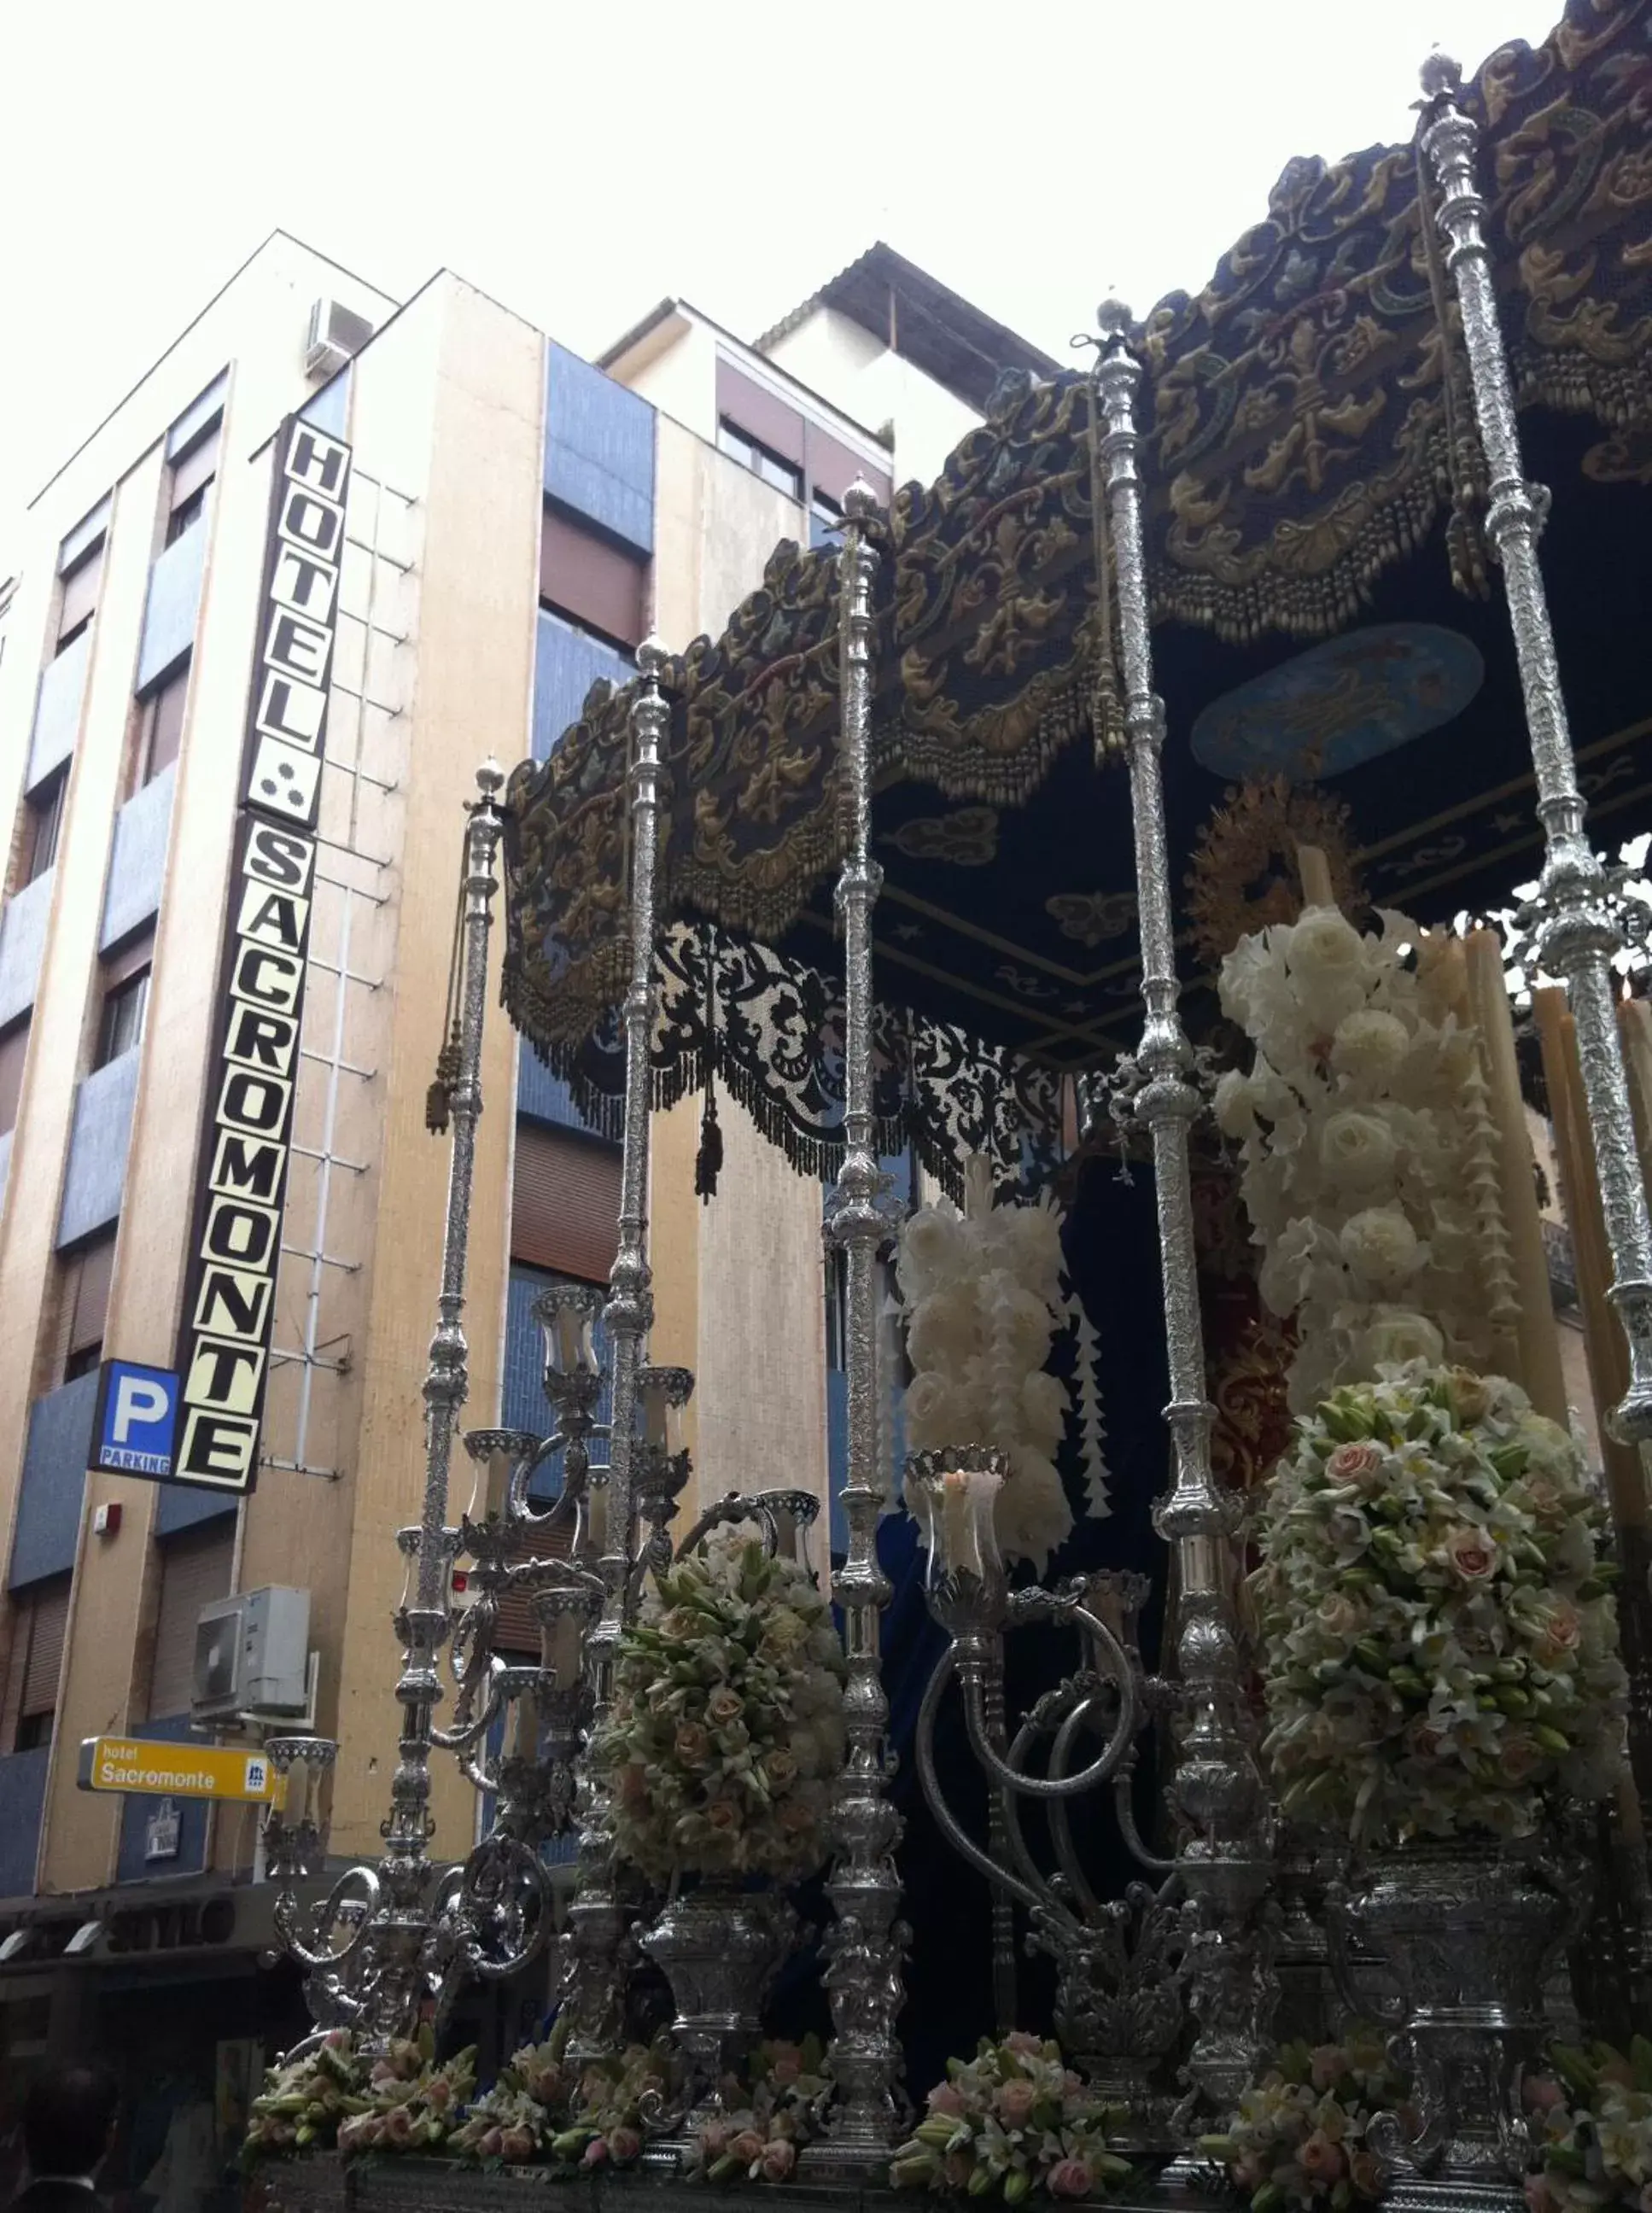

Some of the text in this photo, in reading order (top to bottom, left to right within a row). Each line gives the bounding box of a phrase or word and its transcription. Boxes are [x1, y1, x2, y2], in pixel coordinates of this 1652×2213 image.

[184, 431, 345, 1480] HOTEL SACROMONTE
[113, 1375, 169, 1443] P
[100, 1446, 170, 1474] PARKING
[103, 1743, 137, 1760] hotel
[102, 1762, 215, 1789] Sacromonte
